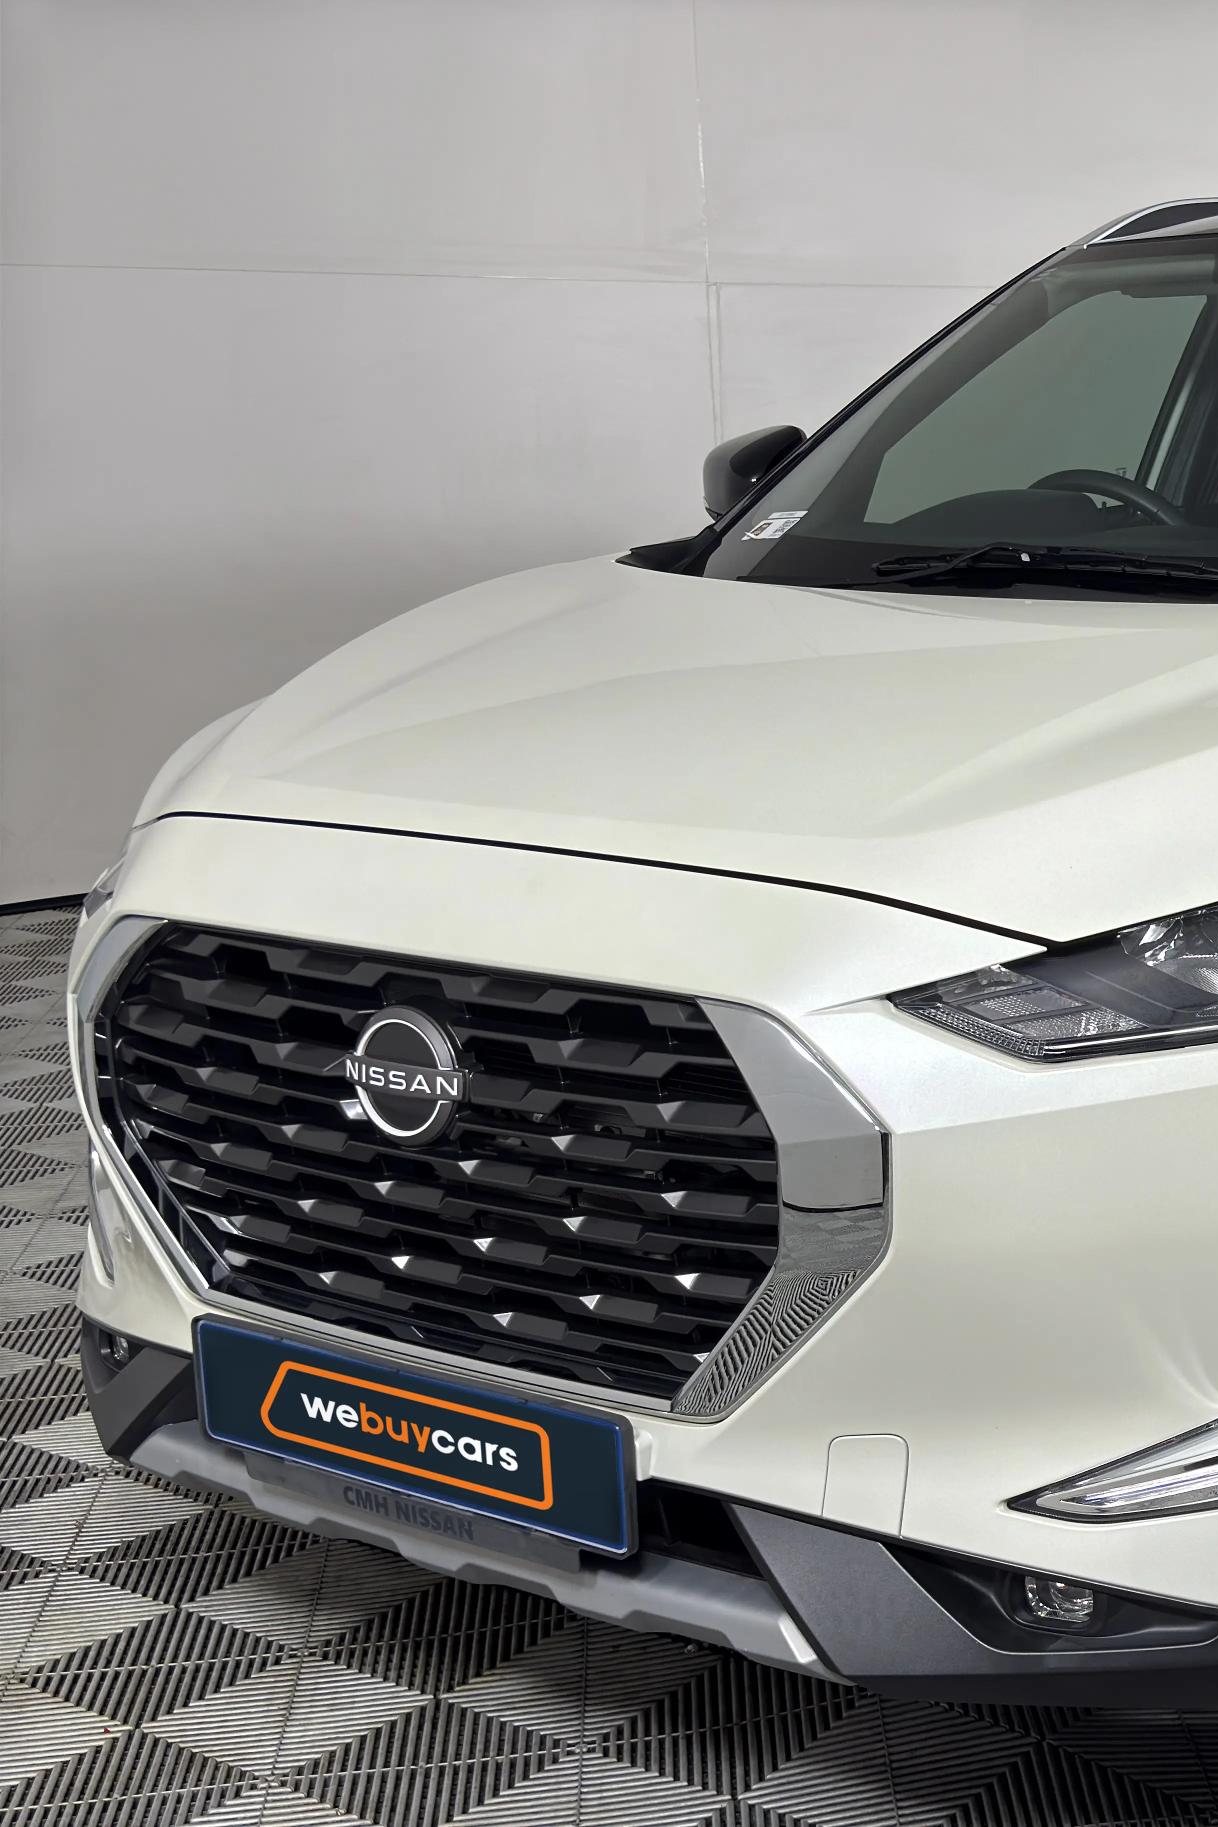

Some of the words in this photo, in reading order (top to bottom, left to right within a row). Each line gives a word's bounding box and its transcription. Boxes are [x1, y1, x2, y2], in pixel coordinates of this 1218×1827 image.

[347, 1059, 458, 1096] NISSAN
[300, 1393, 519, 1472] webuycars
[342, 1485, 389, 1516] CMH
[394, 1499, 473, 1540] NISSAN
